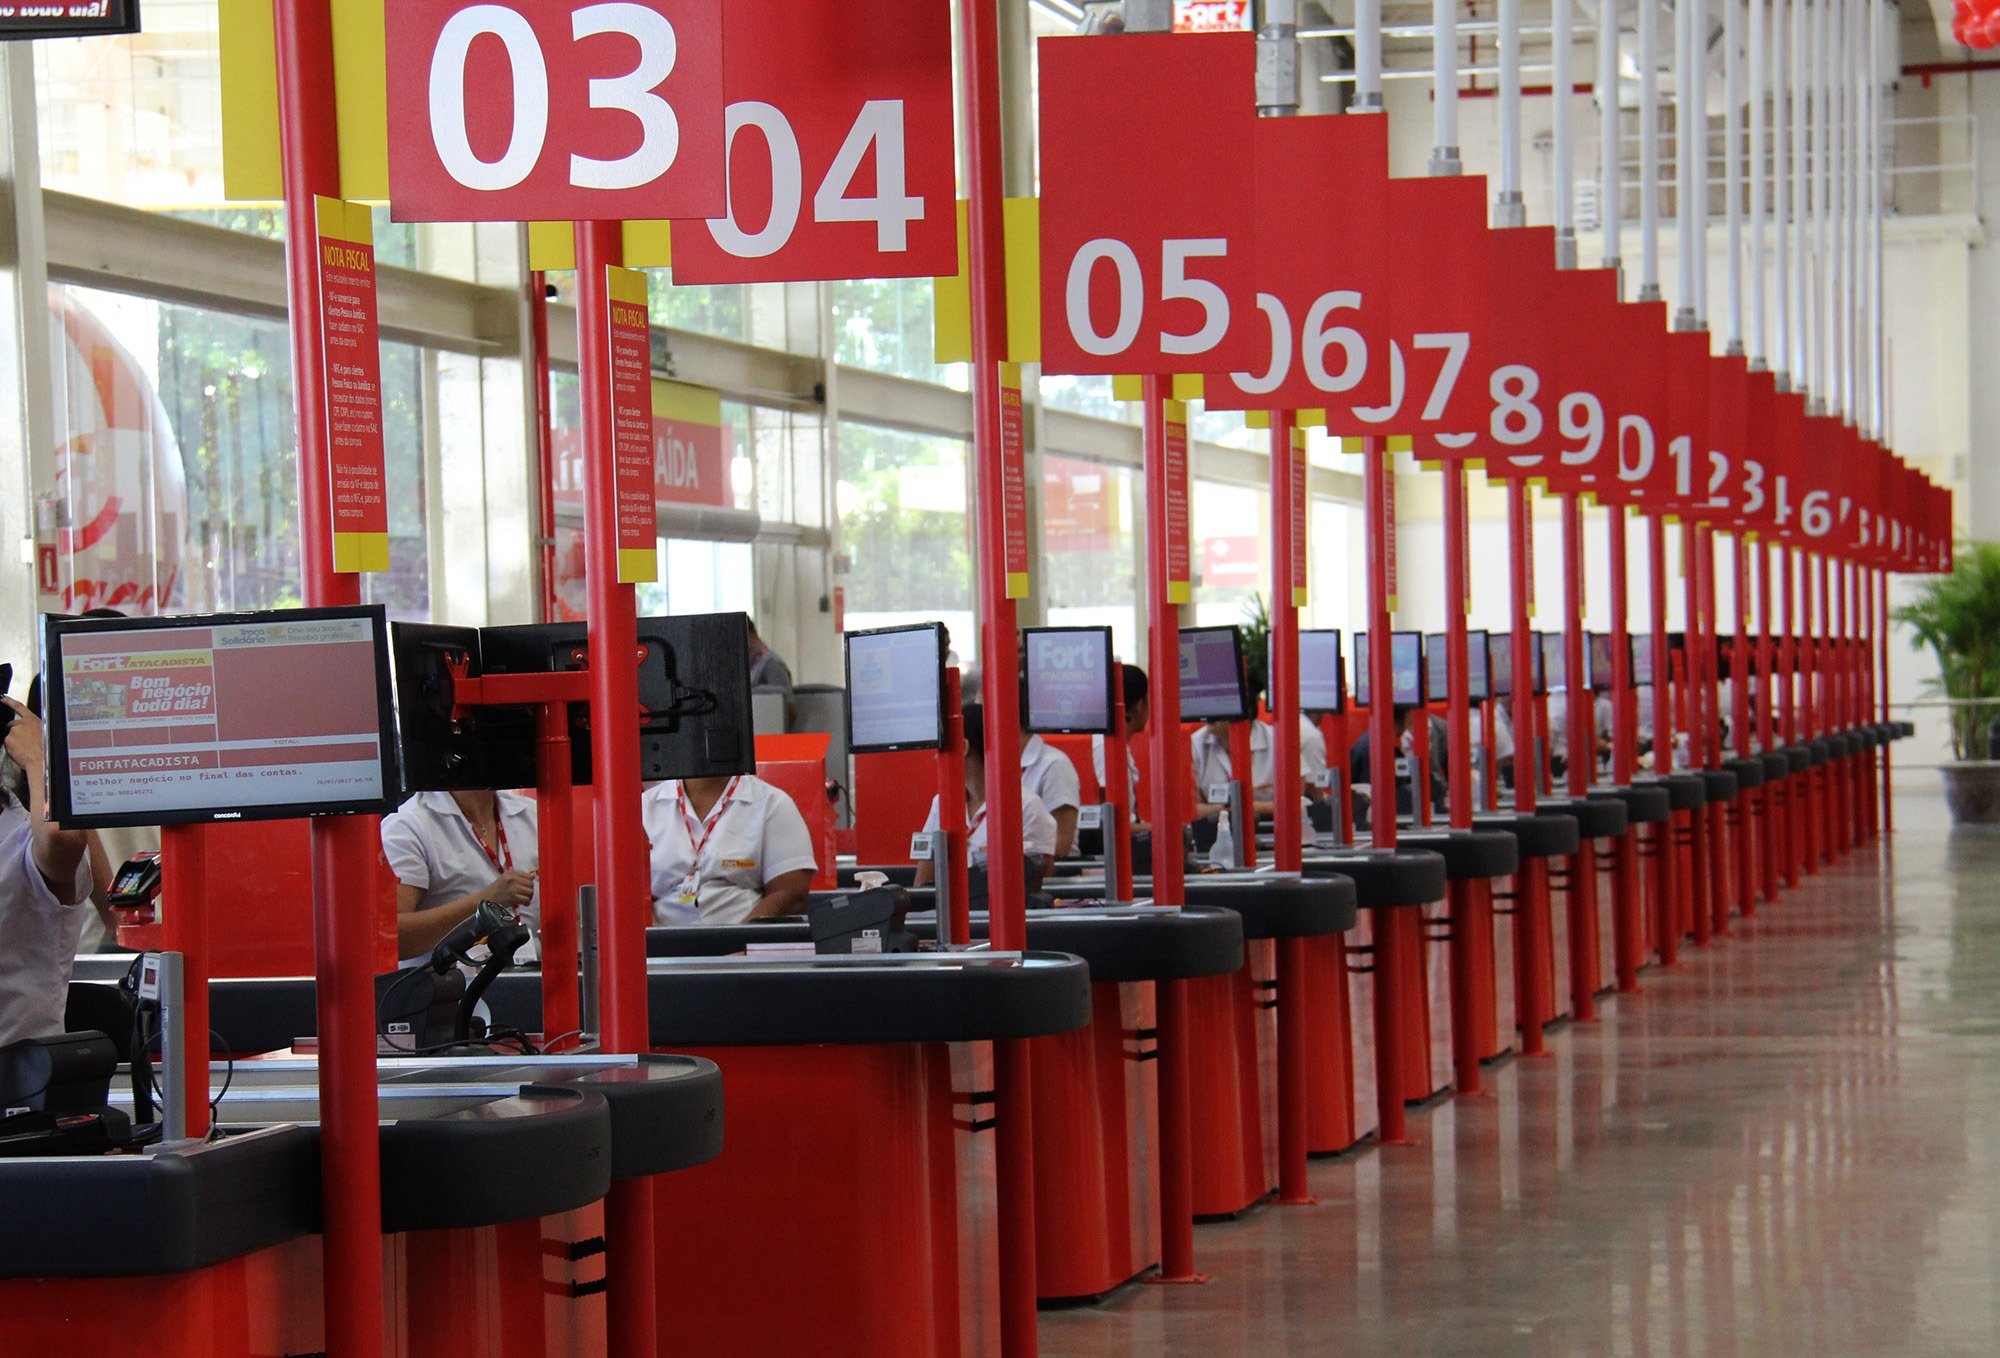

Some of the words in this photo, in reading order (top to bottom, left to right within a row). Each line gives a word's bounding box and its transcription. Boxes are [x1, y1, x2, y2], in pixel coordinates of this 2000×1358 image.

[1174, 0, 1241, 24] Fort
[428, 2, 679, 190] 03
[705, 99, 924, 258] 04
[324, 245, 344, 267] NOTA
[346, 249, 370, 271] FISCAL
[1065, 238, 1231, 356] 05
[655, 426, 700, 489] AÍDA
[78, 656, 124, 671] Fort
[128, 657, 206, 669] ATACADISTA
[1038, 639, 1095, 670] Fort
[130, 676, 171, 690] Bom
[142, 683, 212, 701] negócio
[132, 698, 170, 713] todo
[174, 697, 209, 711] dia!
[79, 756, 200, 771] FORTATACADISTA
[73, 779, 80, 787] O
[86, 777, 123, 787] melhor
[130, 774, 174, 785] negócio
[199, 771, 230, 780] final
[235, 771, 254, 779] das
[260, 769, 303, 777] contas.
